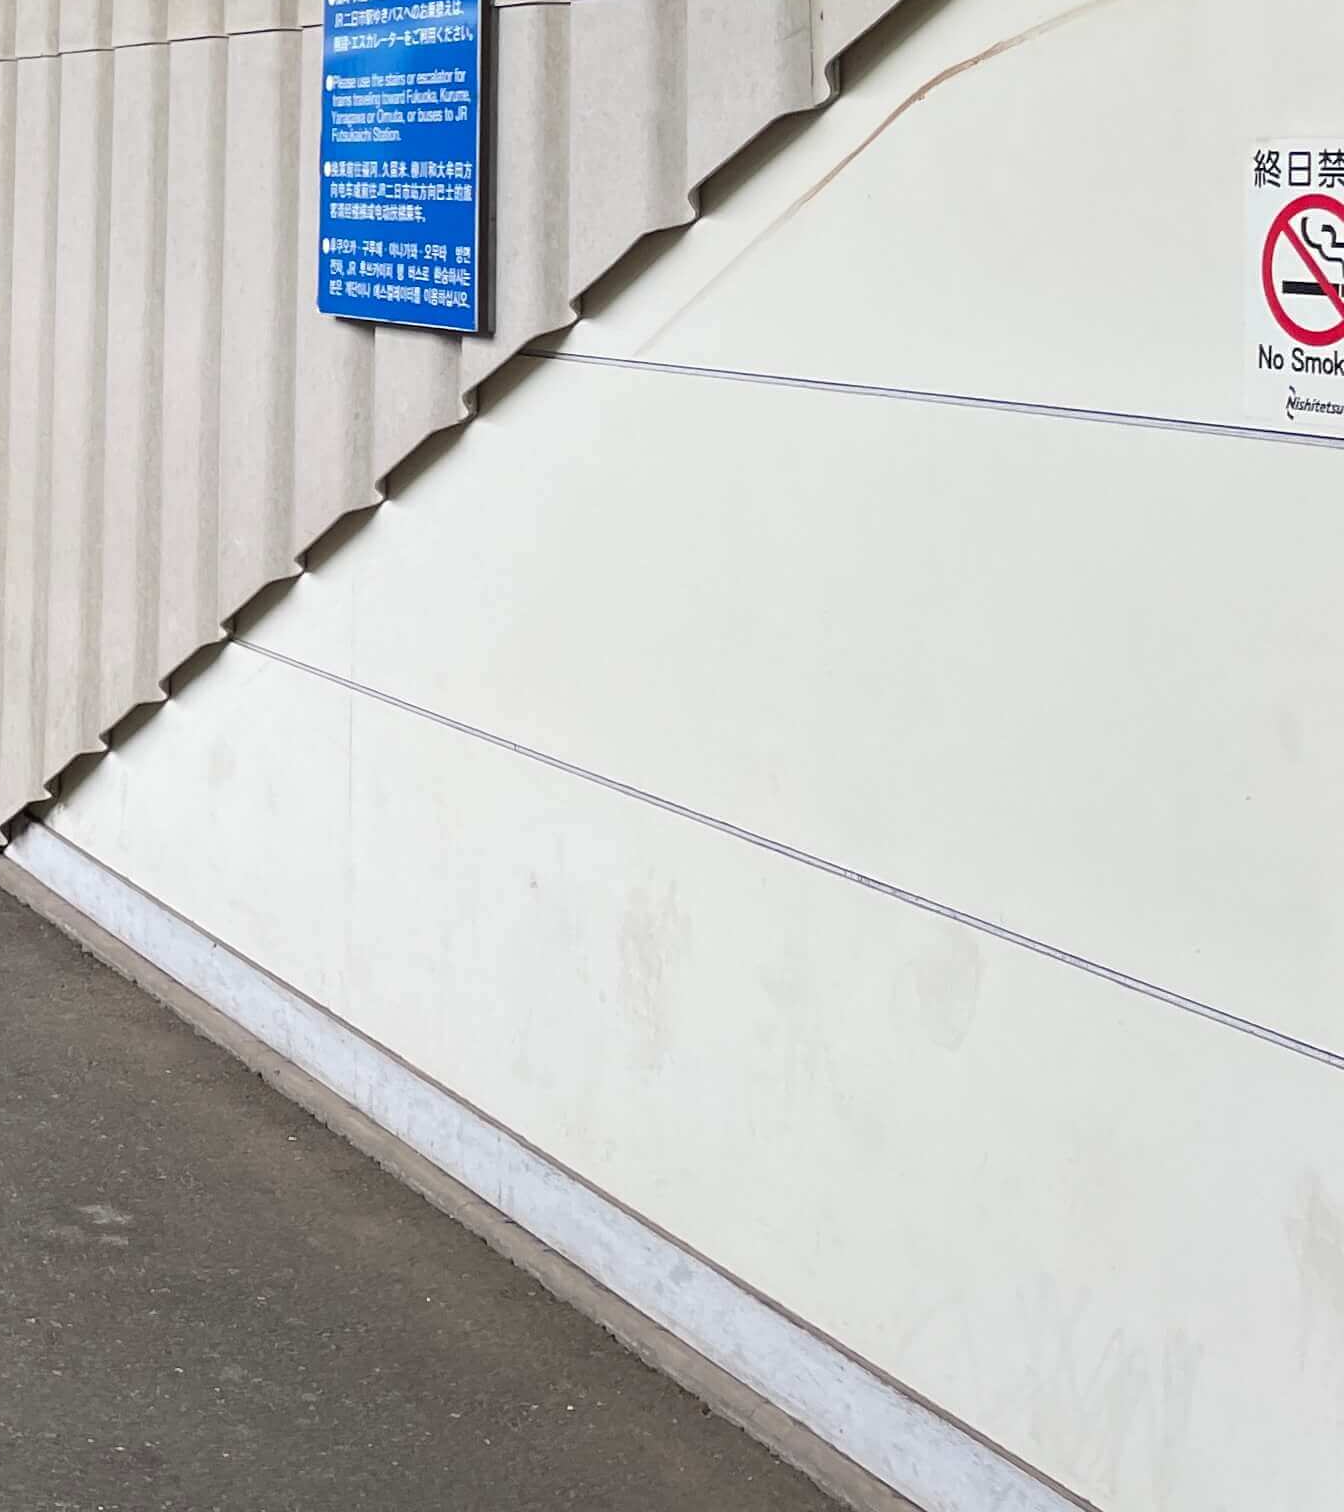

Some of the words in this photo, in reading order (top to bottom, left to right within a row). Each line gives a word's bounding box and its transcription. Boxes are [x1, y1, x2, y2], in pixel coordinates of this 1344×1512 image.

[454, 68, 466, 84] for
[444, 108, 454, 121] to
[455, 106, 468, 121] JR
[1253, 148, 1344, 189] 終日禁
[1258, 344, 1284, 371] No
[1291, 347, 1344, 376] Smok
[1286, 393, 1344, 416] Nishitetsu
